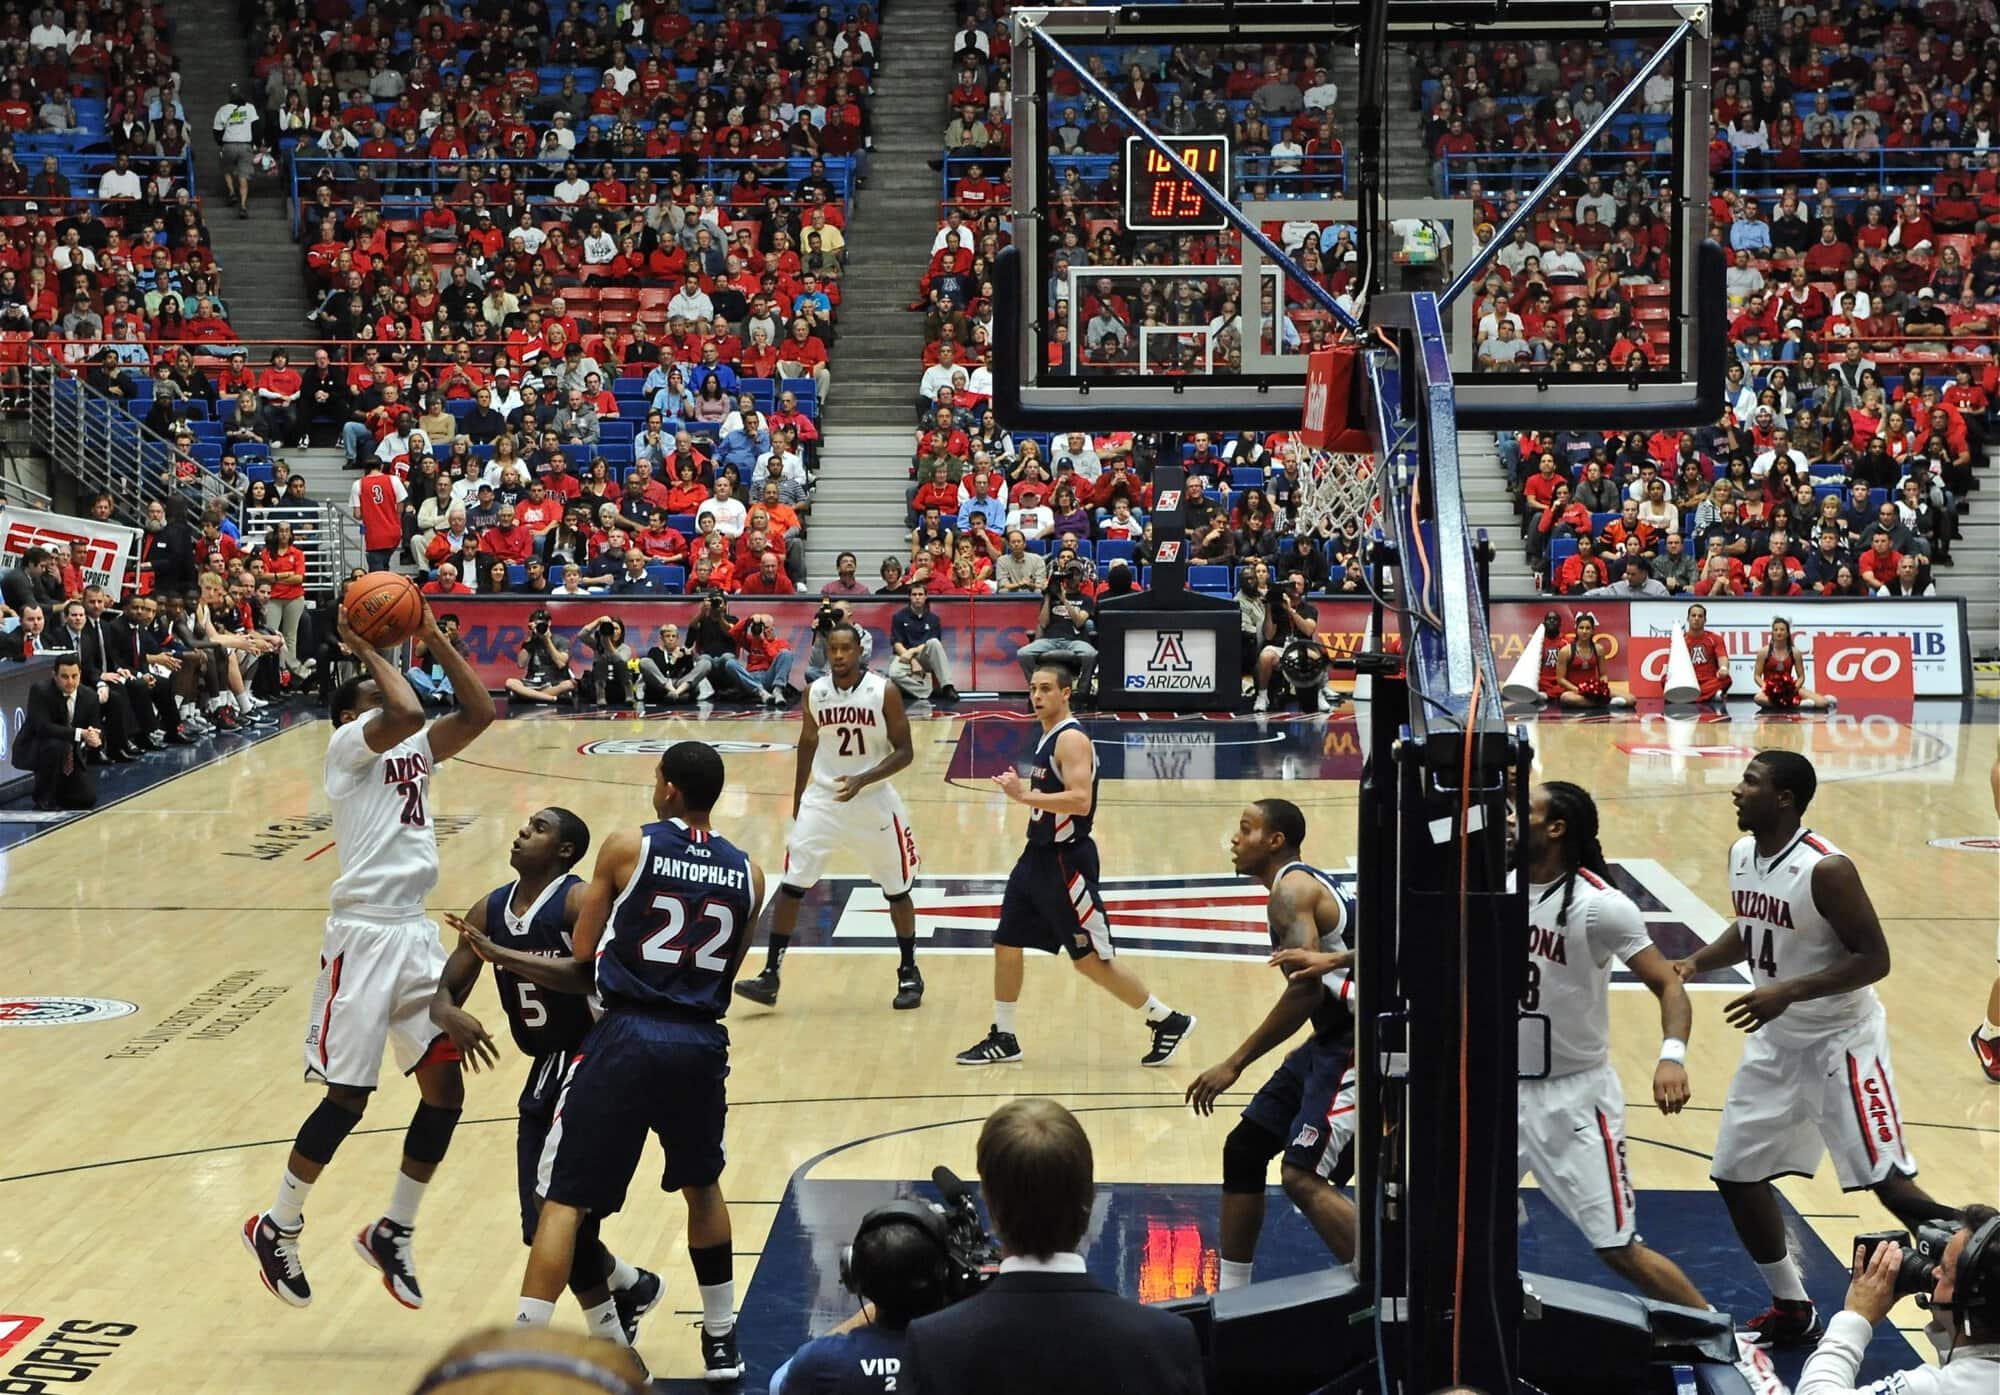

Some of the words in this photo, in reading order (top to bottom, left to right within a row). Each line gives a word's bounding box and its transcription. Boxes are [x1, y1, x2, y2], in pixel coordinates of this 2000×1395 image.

[1152, 181, 1202, 216] 05
[371, 484, 384, 505] 3
[84, 570, 111, 587] SPORTS
[1826, 647, 1901, 682] GO
[1145, 675, 1212, 689] ARIZONA
[818, 706, 876, 727] ARIZONA
[836, 727, 866, 756] 21
[652, 855, 745, 889] PANTOPHLET
[639, 893, 736, 974] 22
[517, 982, 548, 1027] 5
[1863, 1078, 1893, 1143] CATS
[0, 1319, 138, 1395] PORTS
[860, 1358, 901, 1376] VID
[884, 1376, 897, 1391] 2
